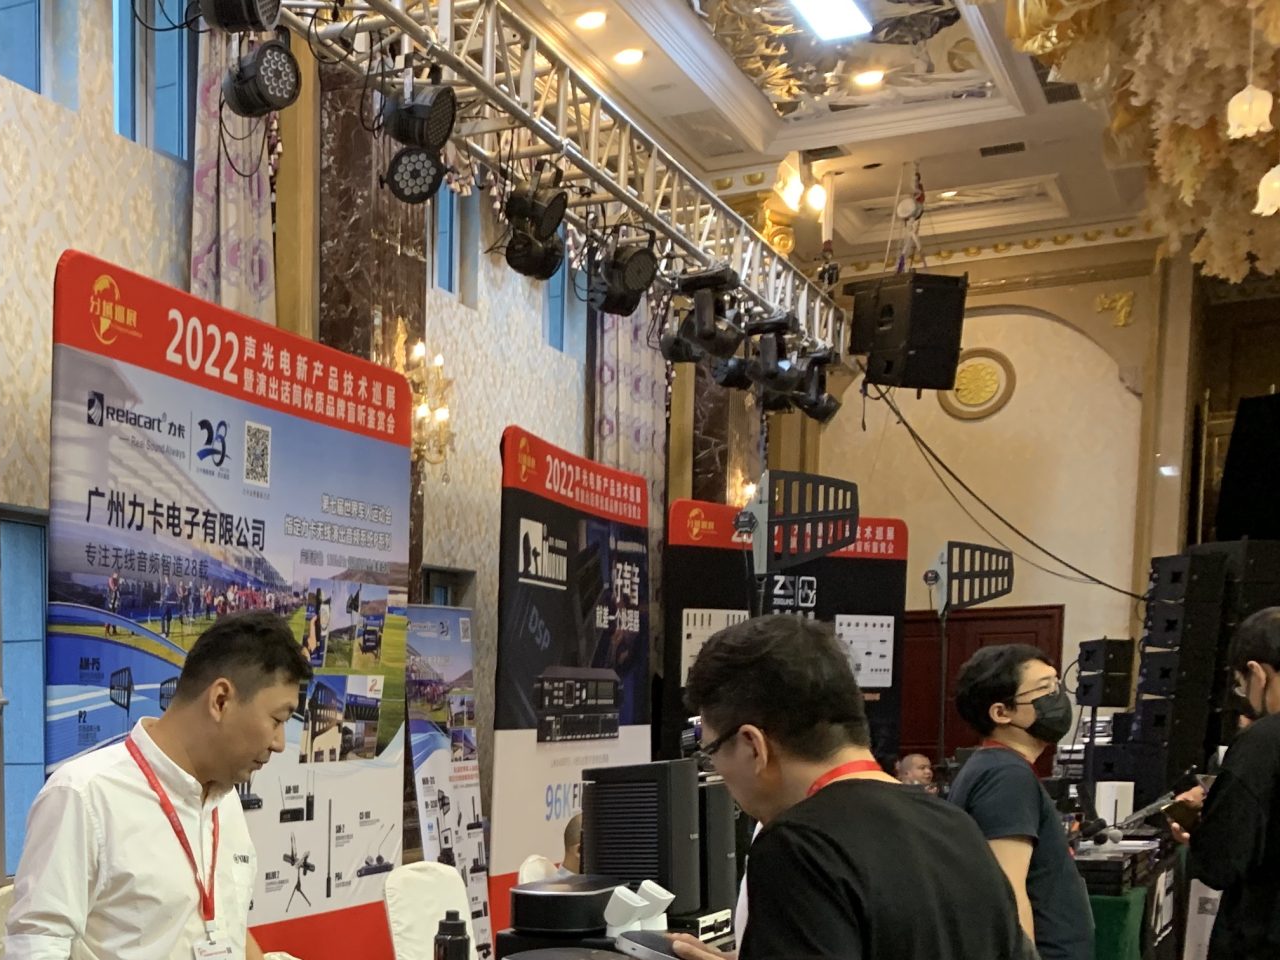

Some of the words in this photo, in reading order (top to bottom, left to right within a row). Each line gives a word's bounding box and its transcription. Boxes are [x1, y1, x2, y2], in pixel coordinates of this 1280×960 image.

[165, 308, 240, 385] 2022
[243, 335, 397, 411] 声光电新产品技术巡展
[105, 405, 163, 434] Relacart
[167, 421, 186, 440] 力卡
[242, 367, 396, 435] 暨演出话筒优质品牌盲听鉴赏会
[544, 454, 575, 499] 2022
[86, 485, 266, 553] 广州力卡电子有限公司
[84, 541, 210, 581] 专注无线音频智造28载
